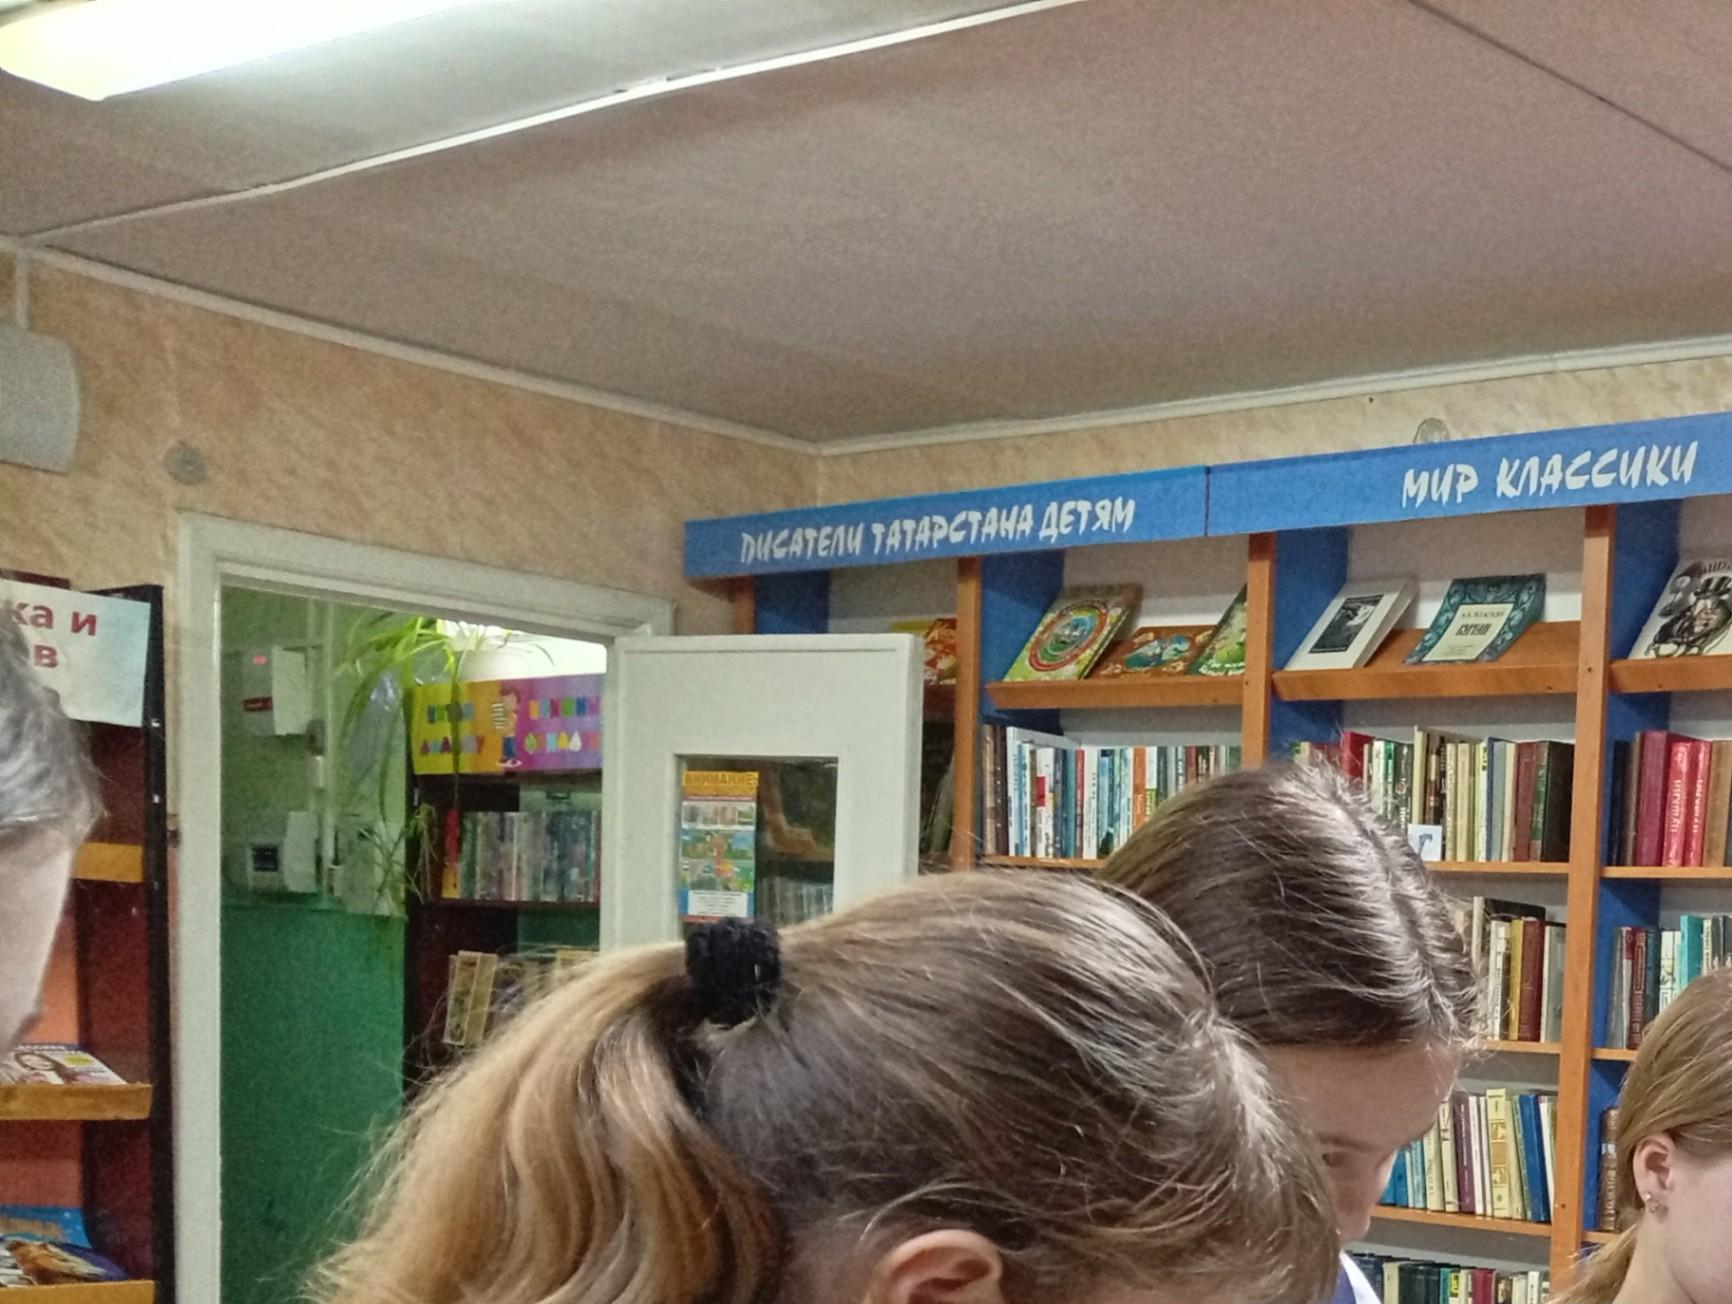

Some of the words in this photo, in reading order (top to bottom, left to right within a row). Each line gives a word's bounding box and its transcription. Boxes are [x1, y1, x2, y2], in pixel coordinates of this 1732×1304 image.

[1402, 464, 1478, 509] МИР
[1496, 441, 1699, 497] КЛАССИКИ
[740, 522, 862, 564] ПИСАТЕЛИ
[872, 503, 1033, 553] ТАТАРСТАНА
[1039, 496, 1136, 543] ДЕТЯМ
[71, 611, 97, 636] и
[1669, 778, 1683, 832] ПУШКИН
